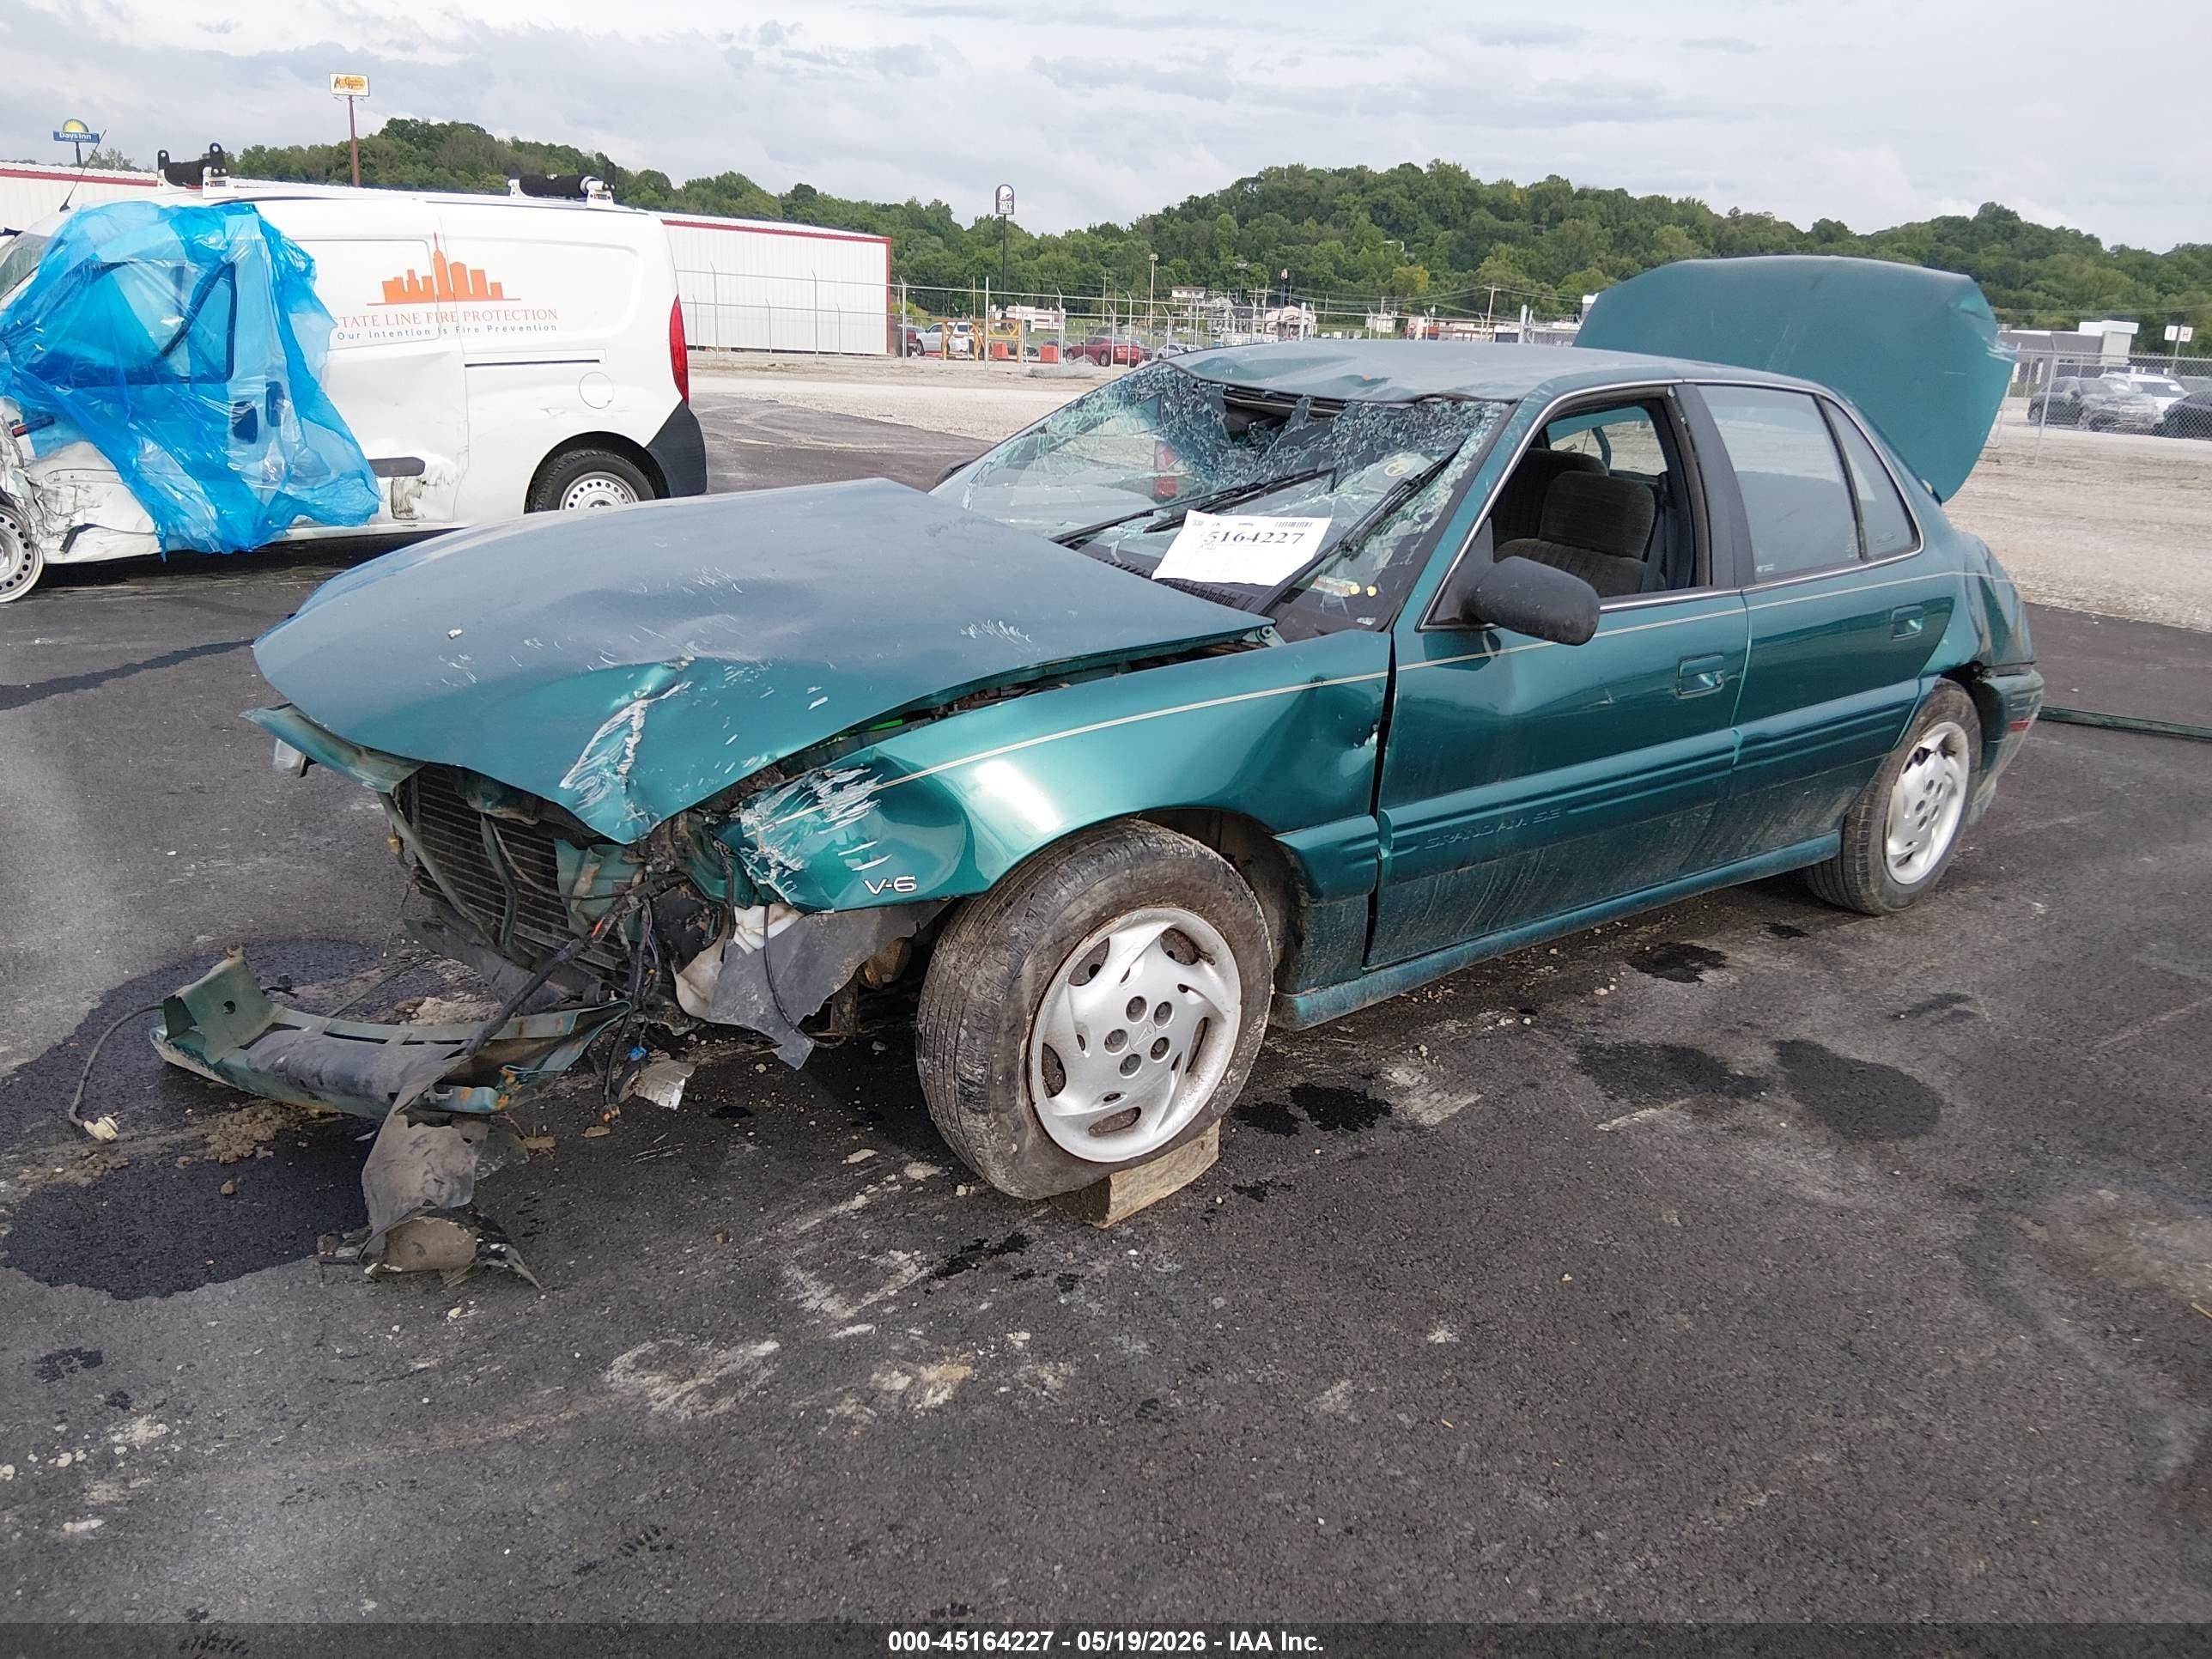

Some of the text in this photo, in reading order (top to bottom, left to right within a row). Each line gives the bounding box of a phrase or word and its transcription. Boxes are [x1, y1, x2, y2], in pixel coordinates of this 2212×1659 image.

[334, 308, 557, 328] TATE LINE FIRE PROTECTION
[337, 331, 361, 340] Our
[369, 328, 431, 338] Intention
[455, 325, 480, 334] Fire
[487, 323, 557, 333] Prevention
[863, 875, 917, 895] V-6
